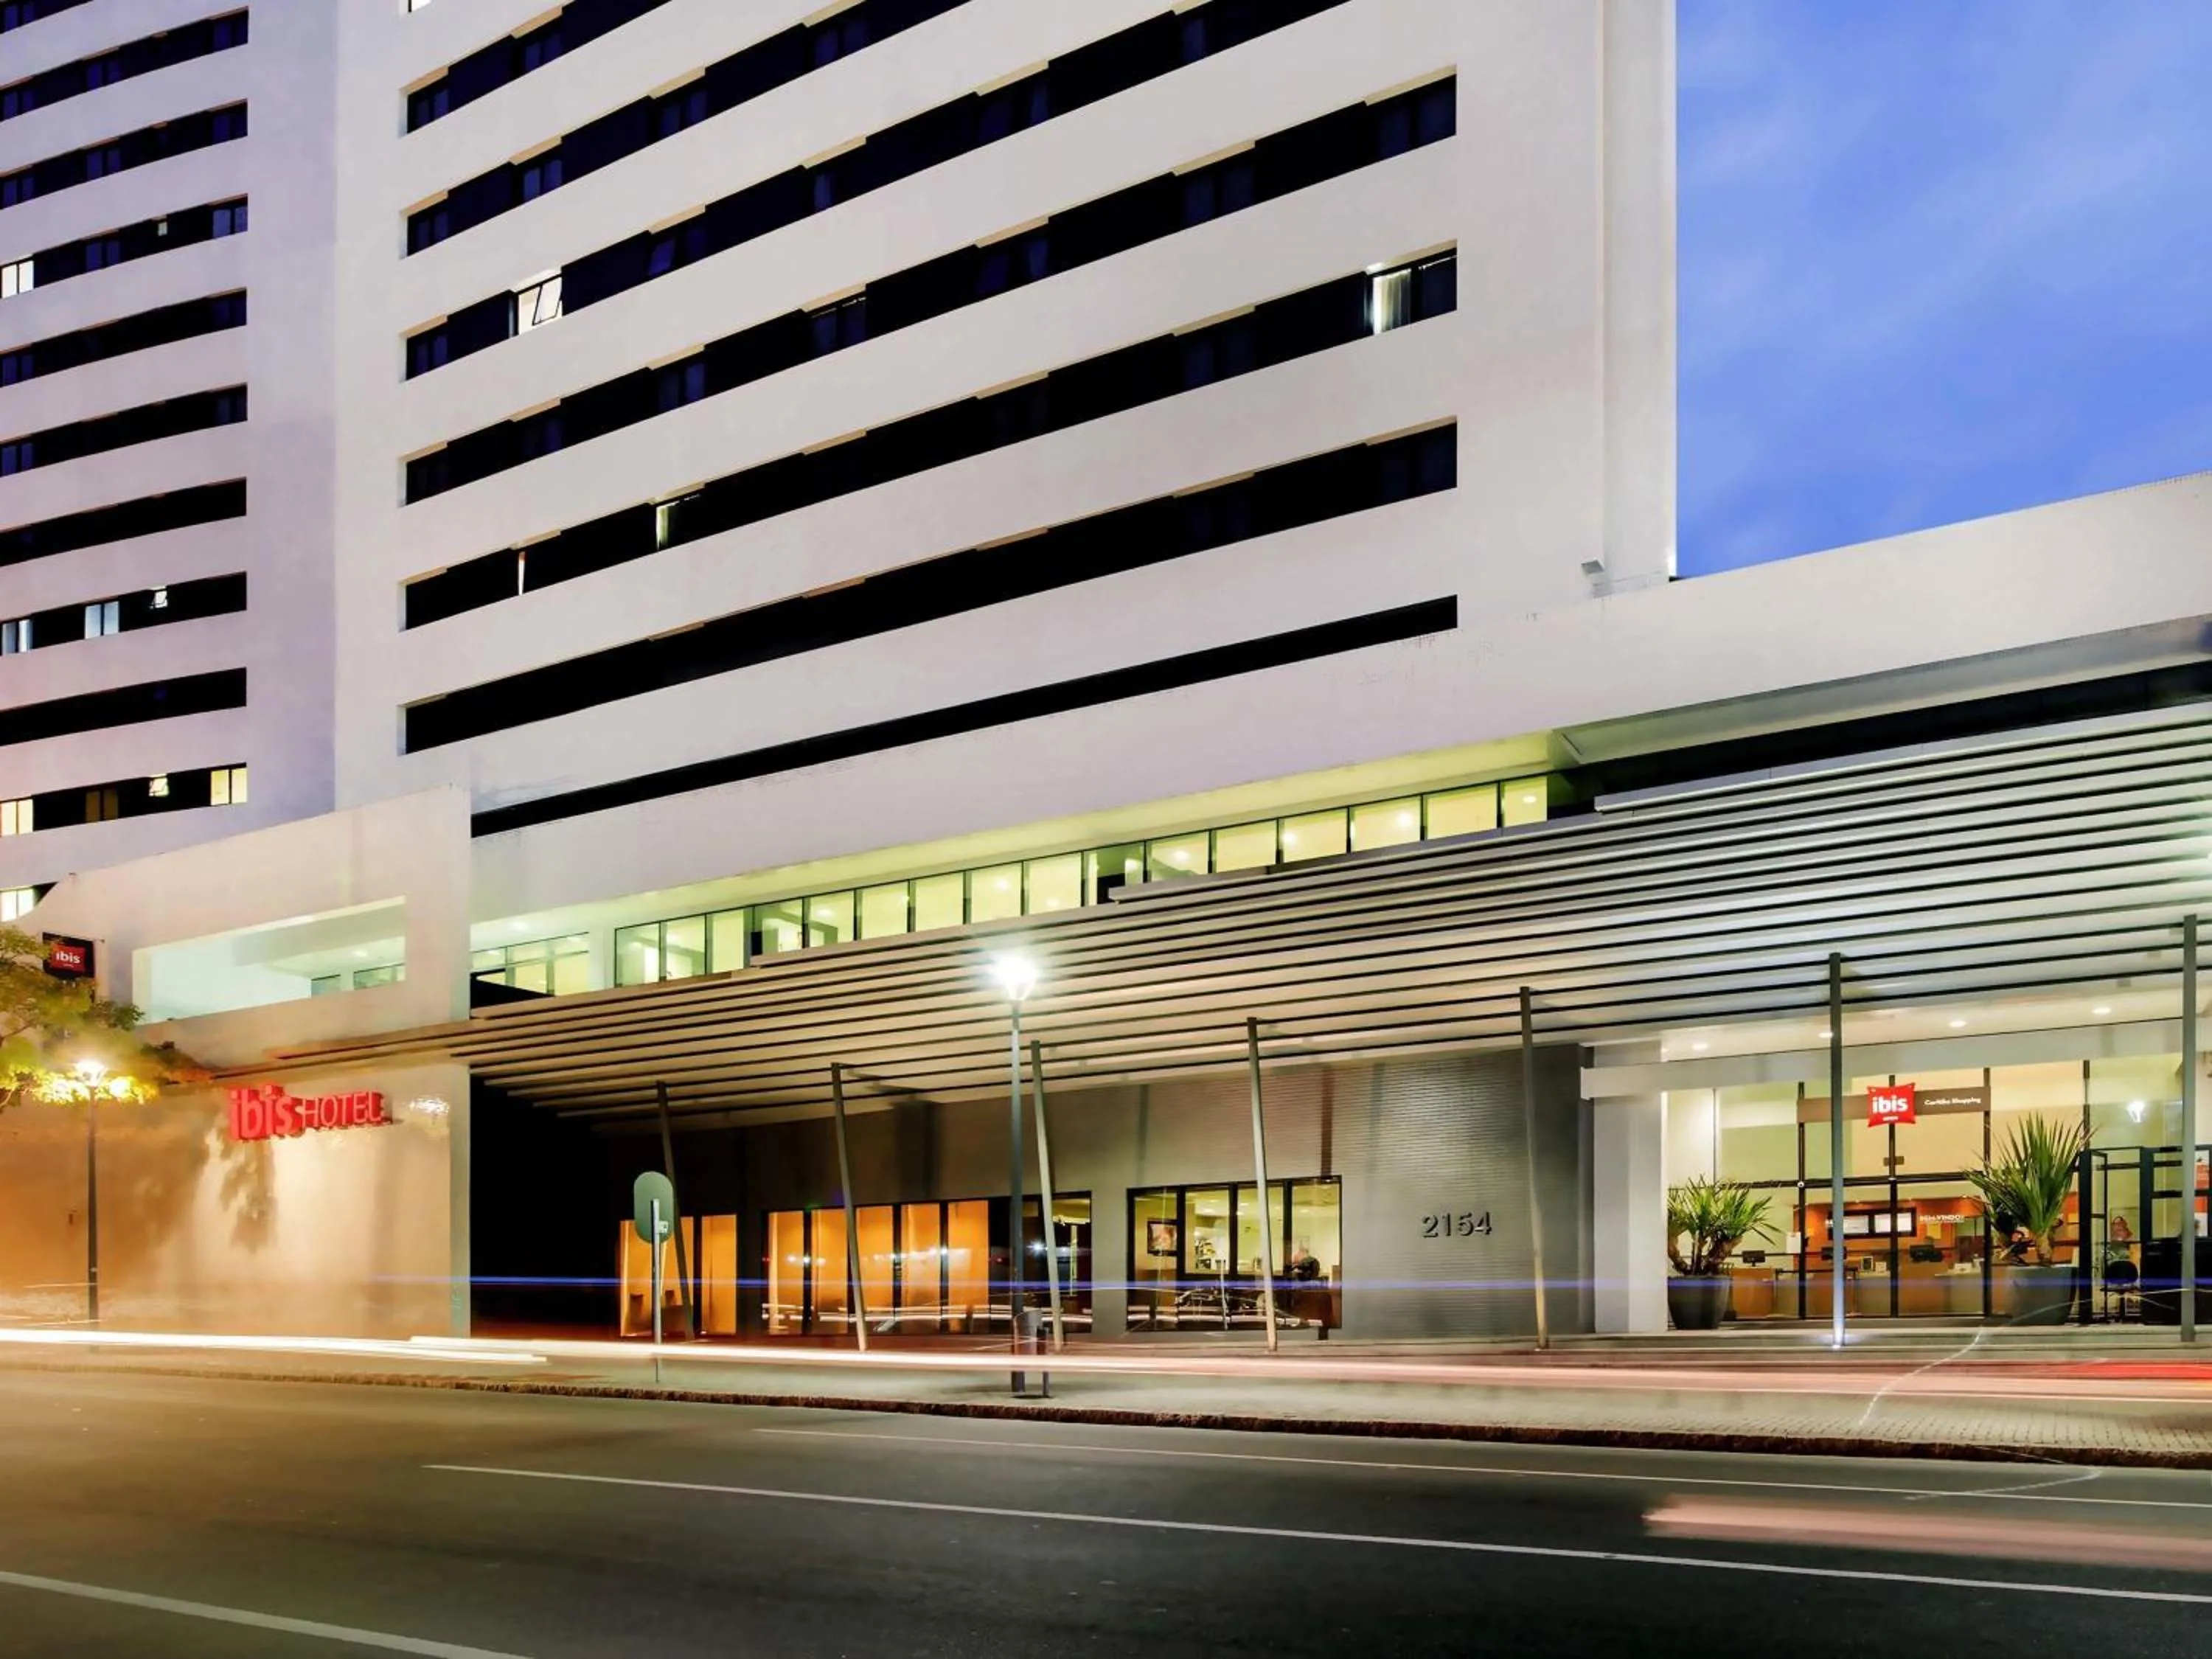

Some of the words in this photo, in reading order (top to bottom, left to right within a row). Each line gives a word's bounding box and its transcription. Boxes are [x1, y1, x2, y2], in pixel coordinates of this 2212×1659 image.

[55, 950, 80, 964] ibis
[230, 1085, 294, 1140] ibis
[302, 1091, 384, 1127] HOTEL
[1871, 1094, 1908, 1114] ibis
[1422, 1211, 1492, 1239] 2154
